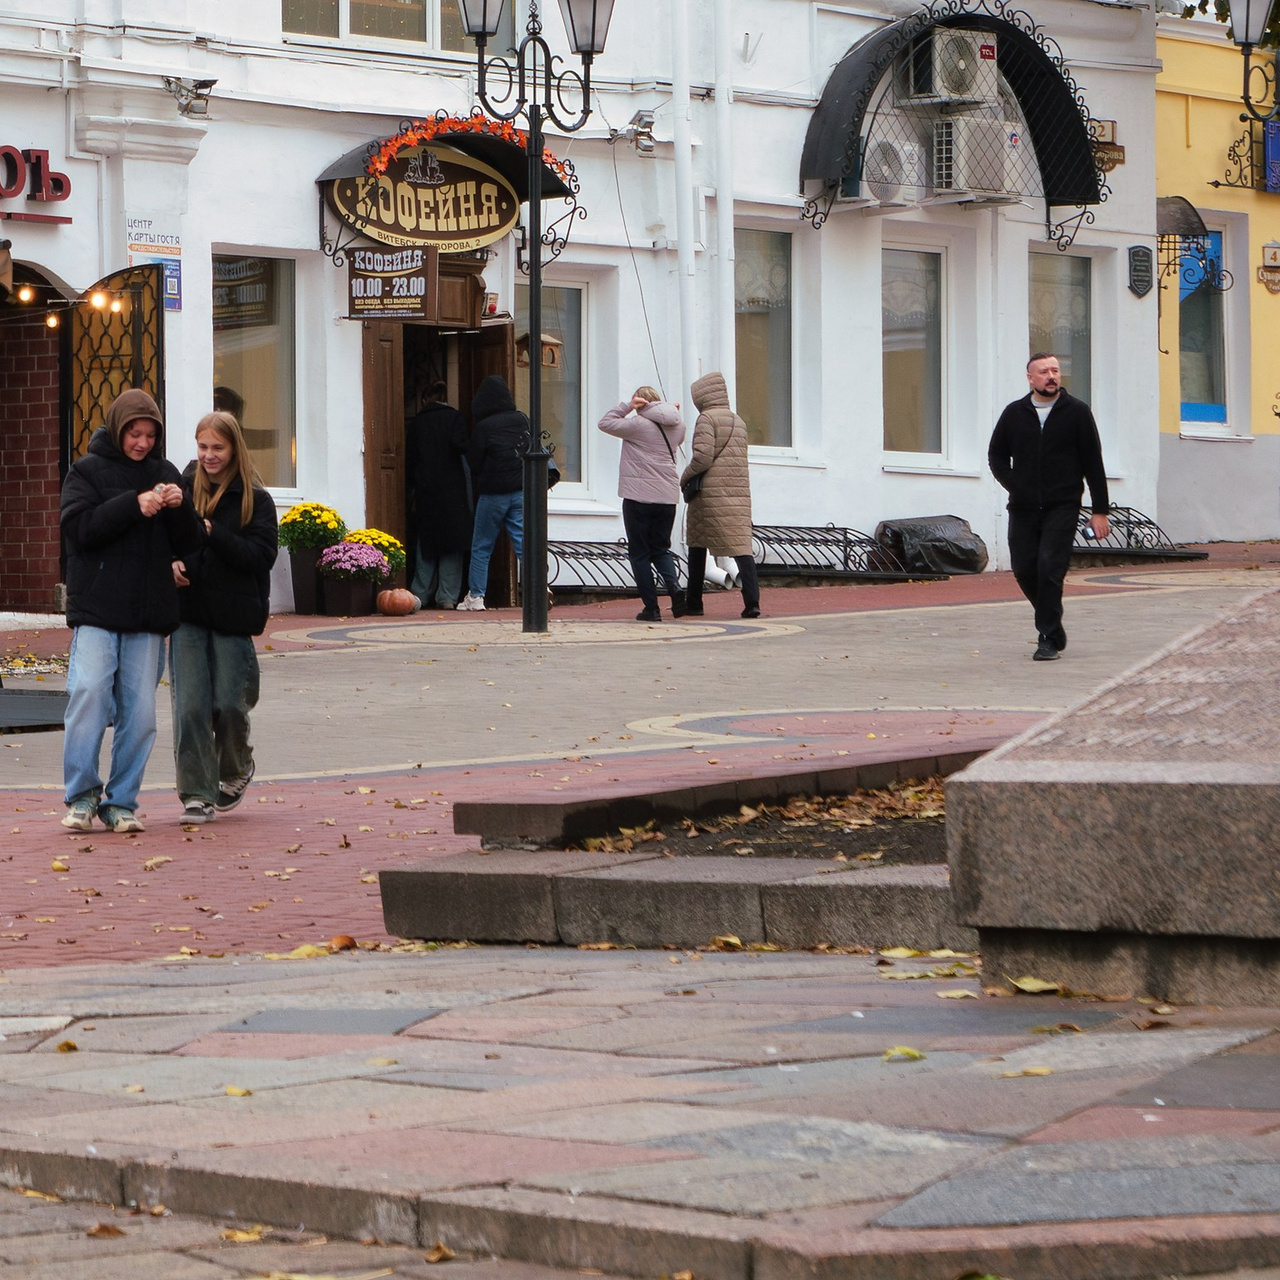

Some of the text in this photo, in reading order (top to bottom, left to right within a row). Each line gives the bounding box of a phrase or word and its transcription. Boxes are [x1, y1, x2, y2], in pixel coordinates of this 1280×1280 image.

[981, 48, 994, 57] TCL
[1097, 124, 1106, 138] 2
[355, 175, 500, 232] КОФЕЙНЯ
[127, 218, 153, 229] ЦЕНТР
[127, 231, 180, 245] КАРТЫ ГОСТЯ
[475, 238, 481, 246] 2
[354, 249, 423, 272] КОФЕЙНЯ
[1270, 250, 1278, 262] 4
[351, 277, 382, 297] 10.00
[392, 276, 426, 297] 23.00
